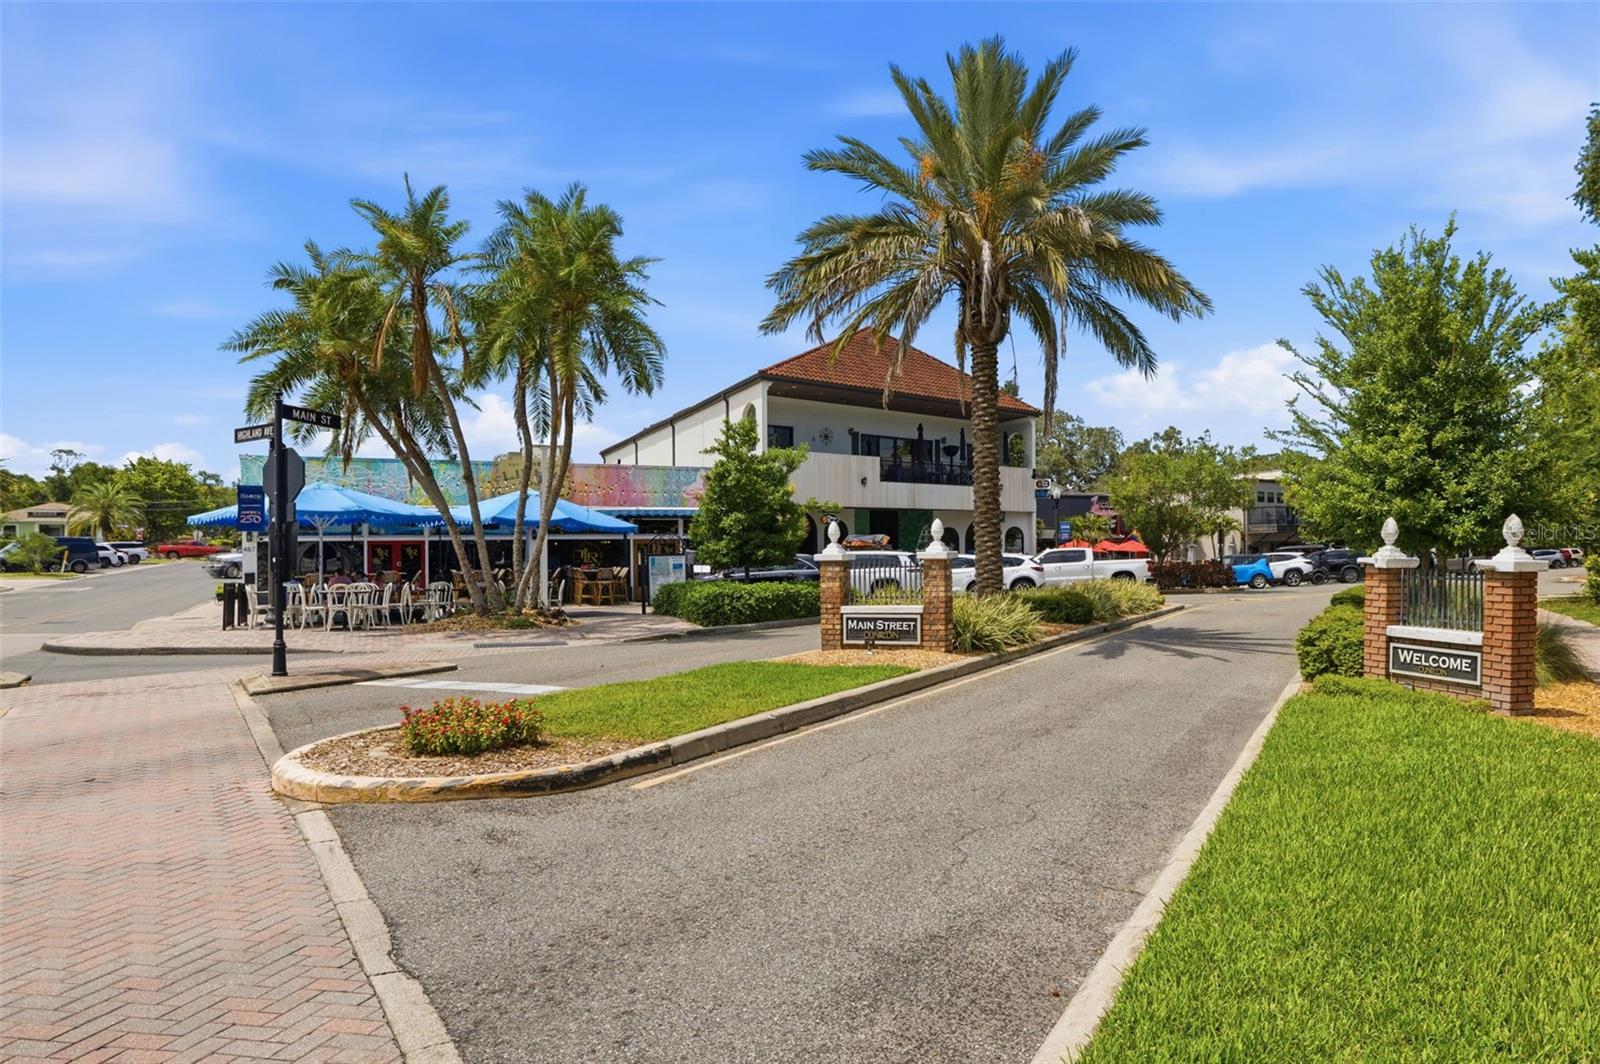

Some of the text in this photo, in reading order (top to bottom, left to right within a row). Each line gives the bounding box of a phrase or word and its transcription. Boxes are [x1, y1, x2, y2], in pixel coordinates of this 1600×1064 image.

[292, 408, 332, 425] MAIN ST
[240, 514, 262, 524] 250
[847, 619, 916, 631] MAIN STREET
[1397, 648, 1472, 672] WELCOME
